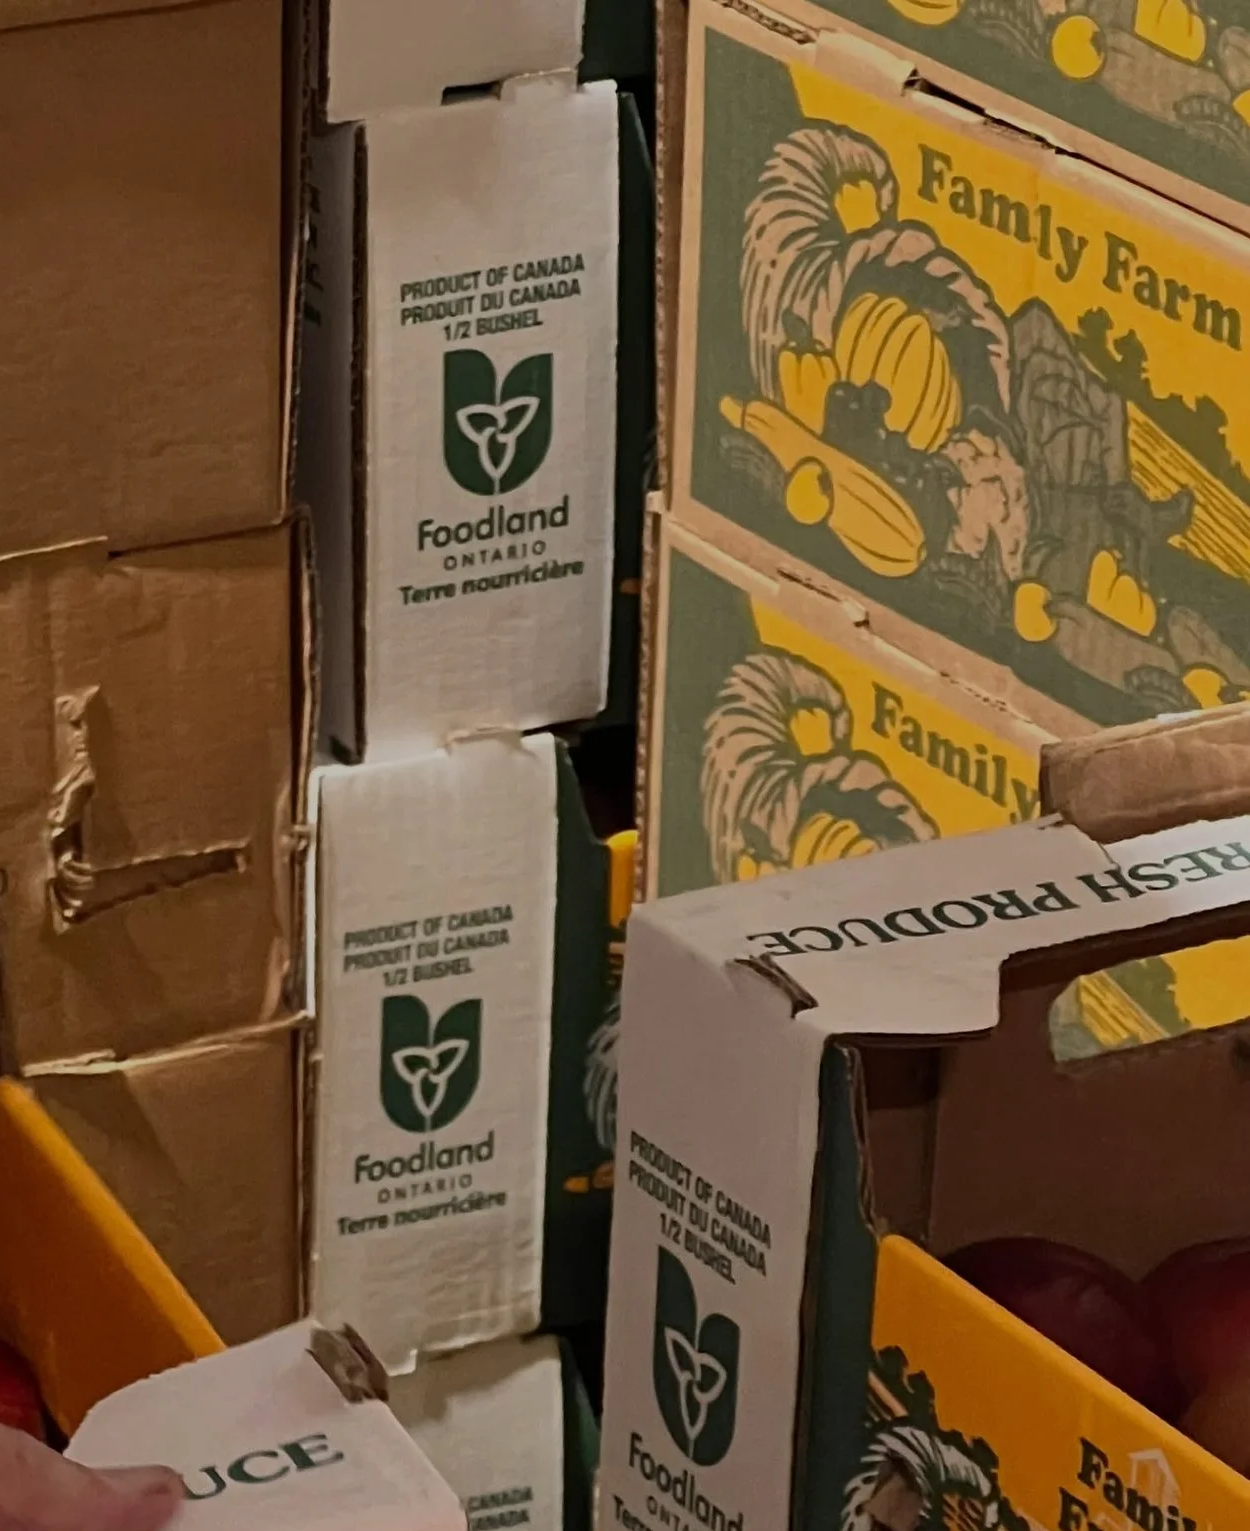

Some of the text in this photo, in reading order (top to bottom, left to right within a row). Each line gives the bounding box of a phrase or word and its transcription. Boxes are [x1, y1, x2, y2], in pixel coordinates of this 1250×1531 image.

[400, 252, 586, 303] PRODUCT OF CANADA
[400, 277, 582, 326] PRODUIT DU CANADA
[1102, 230, 1243, 352] Farm
[442, 307, 544, 342] 1/2 BUSHEL
[417, 494, 570, 551] Foodland
[442, 539, 548, 572] ONTARIO
[398, 557, 586, 608] Terre nourricière
[871, 685, 1042, 824] Family
[746, 841, 1250, 958] RESH PRODUCE
[342, 927, 511, 974] PRODUIT DU CANADA
[343, 903, 514, 951] PRODUCT OF CANADA
[382, 956, 475, 987] 1/2 BUSHEL
[354, 1129, 496, 1184] Foodland
[377, 1172, 474, 1205] ONTARIO
[629, 1130, 772, 1251] PRODUCT OF CANADA
[336, 1212, 391, 1238] Terre
[628, 1159, 768, 1278] PRODUIT DU CANADA
[659, 1212, 737, 1287] 1/2 BUSHEL
